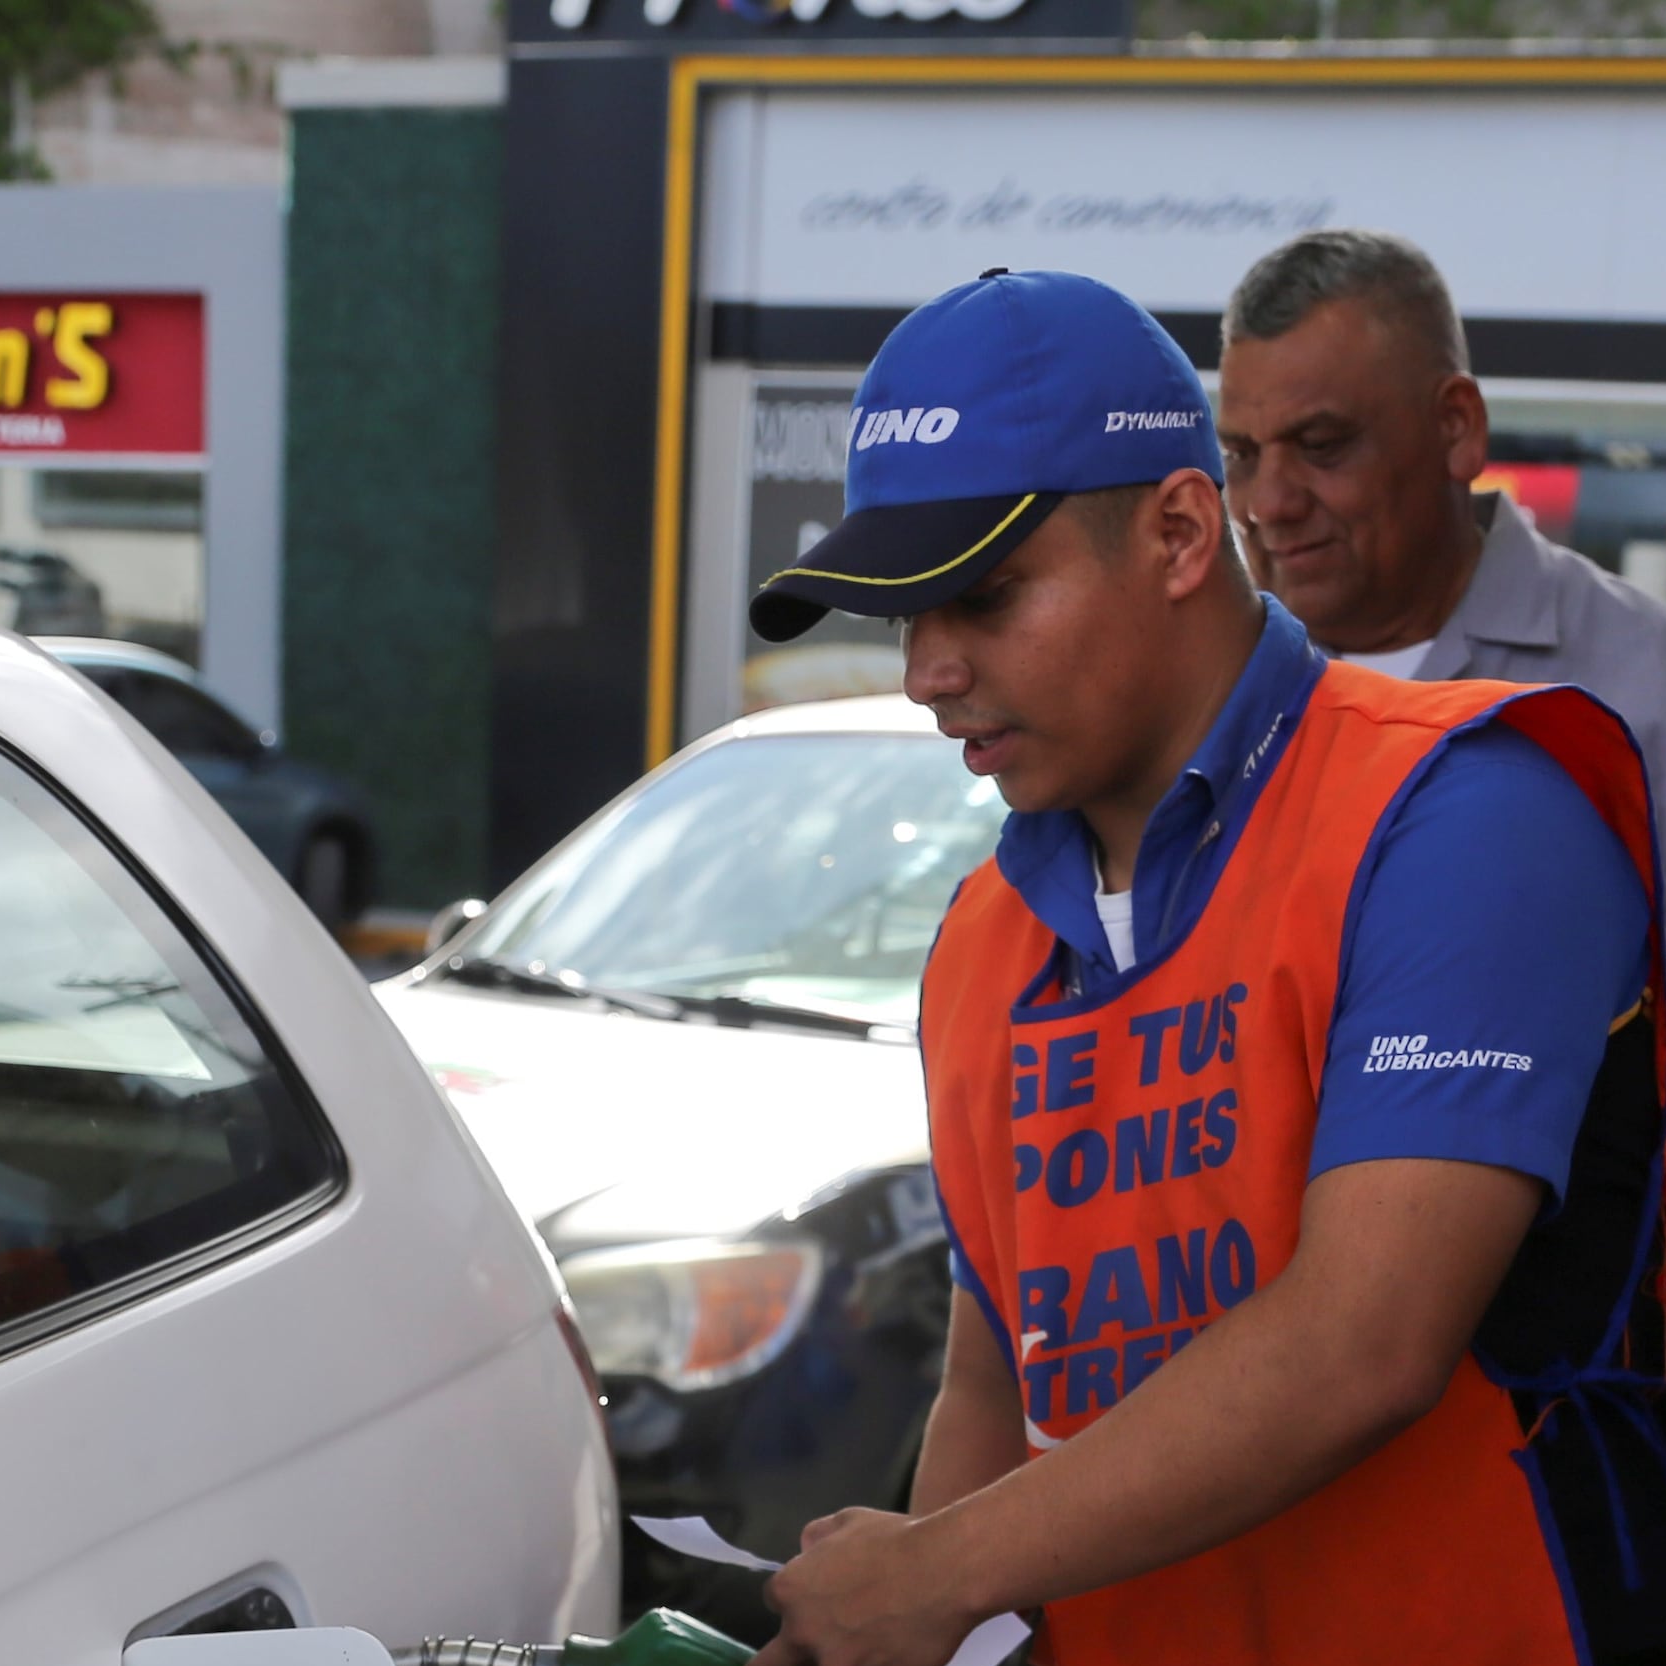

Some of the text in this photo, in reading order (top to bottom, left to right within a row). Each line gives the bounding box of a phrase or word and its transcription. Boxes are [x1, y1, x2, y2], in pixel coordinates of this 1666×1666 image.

[856, 406, 960, 451] UNO
[1104, 411, 1201, 433] DYNAMAX
[1129, 982, 1249, 1087] TUS
[1369, 1034, 1429, 1057] UNO
[1362, 1050, 1533, 1073] LUBRICANTES
